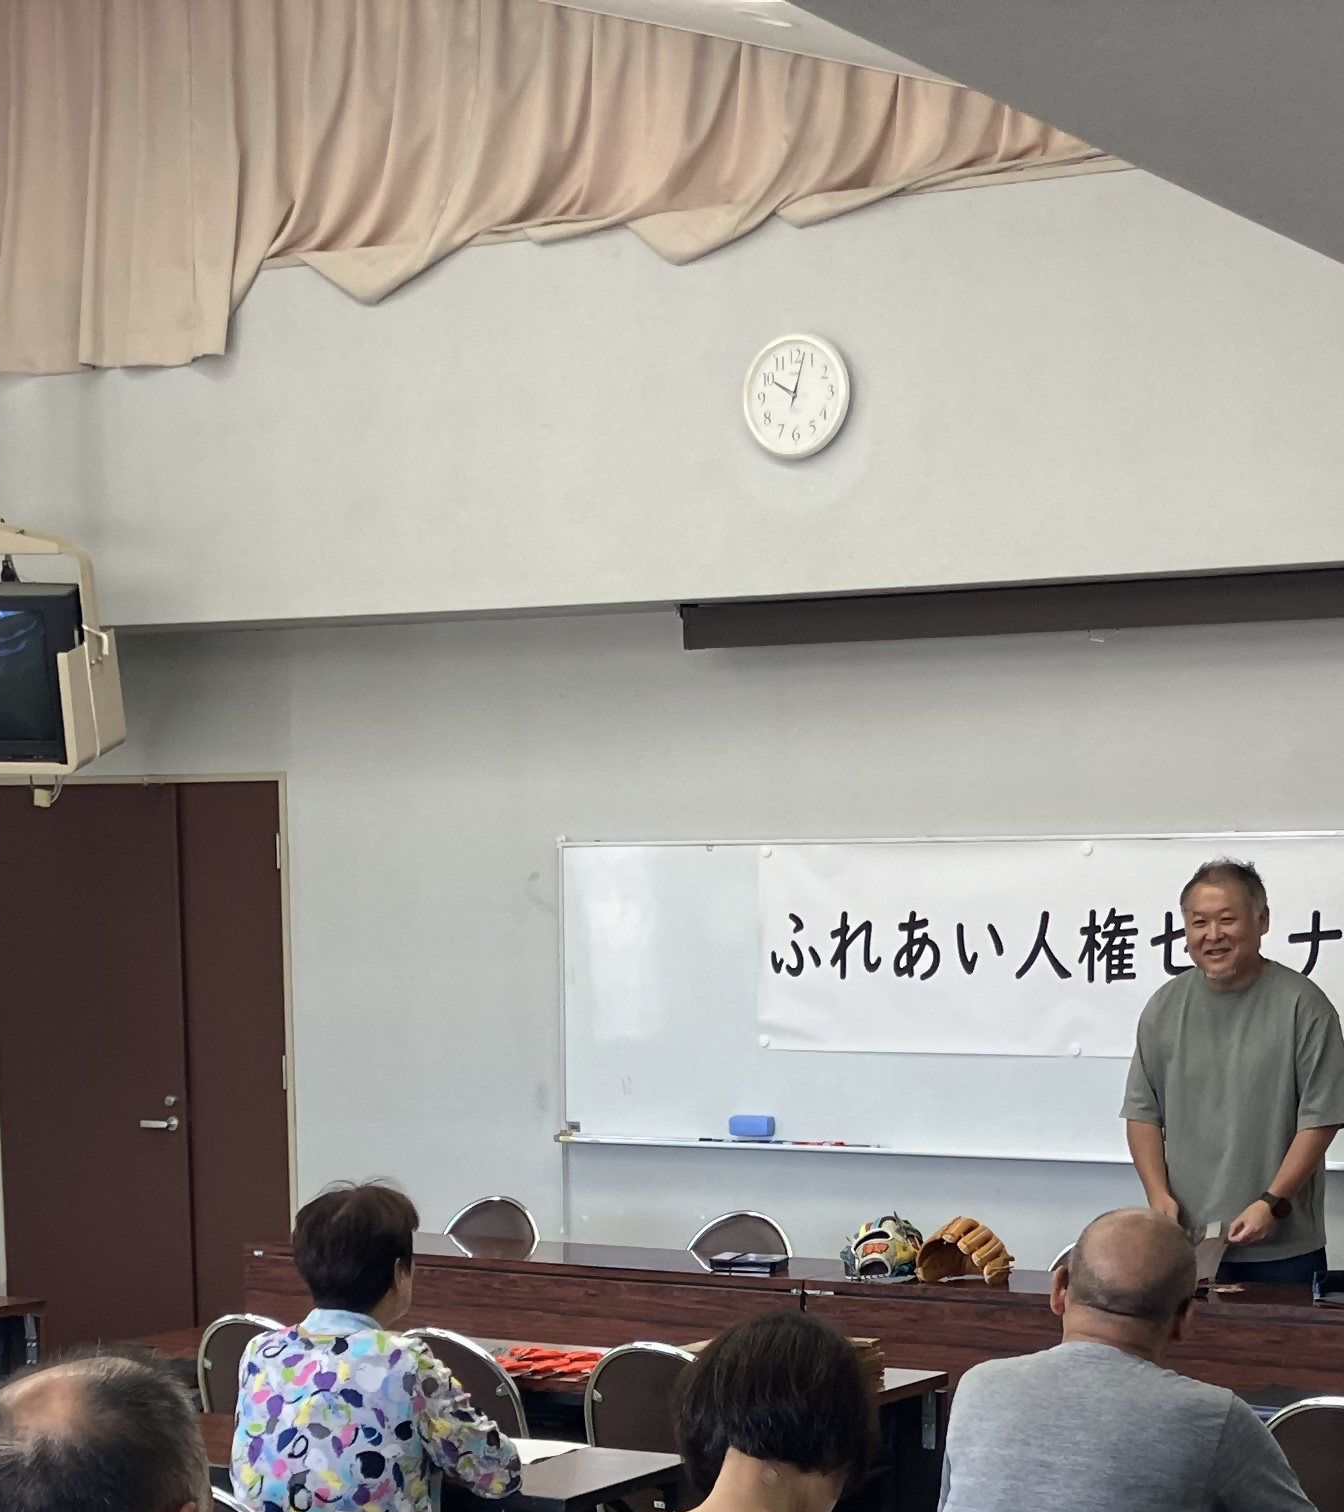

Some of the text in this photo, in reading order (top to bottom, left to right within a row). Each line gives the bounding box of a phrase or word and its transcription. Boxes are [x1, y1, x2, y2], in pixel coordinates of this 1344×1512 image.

[774, 354, 784, 371] 11
[790, 348, 802, 364] 12
[763, 372, 774, 387] 10
[821, 365, 828, 379] 2
[758, 392, 766, 406] 9
[827, 384, 835, 401] 3
[763, 411, 772, 425] 8
[819, 405, 827, 420] 4
[792, 426, 801, 442] 6
[809, 420, 816, 435] 5
